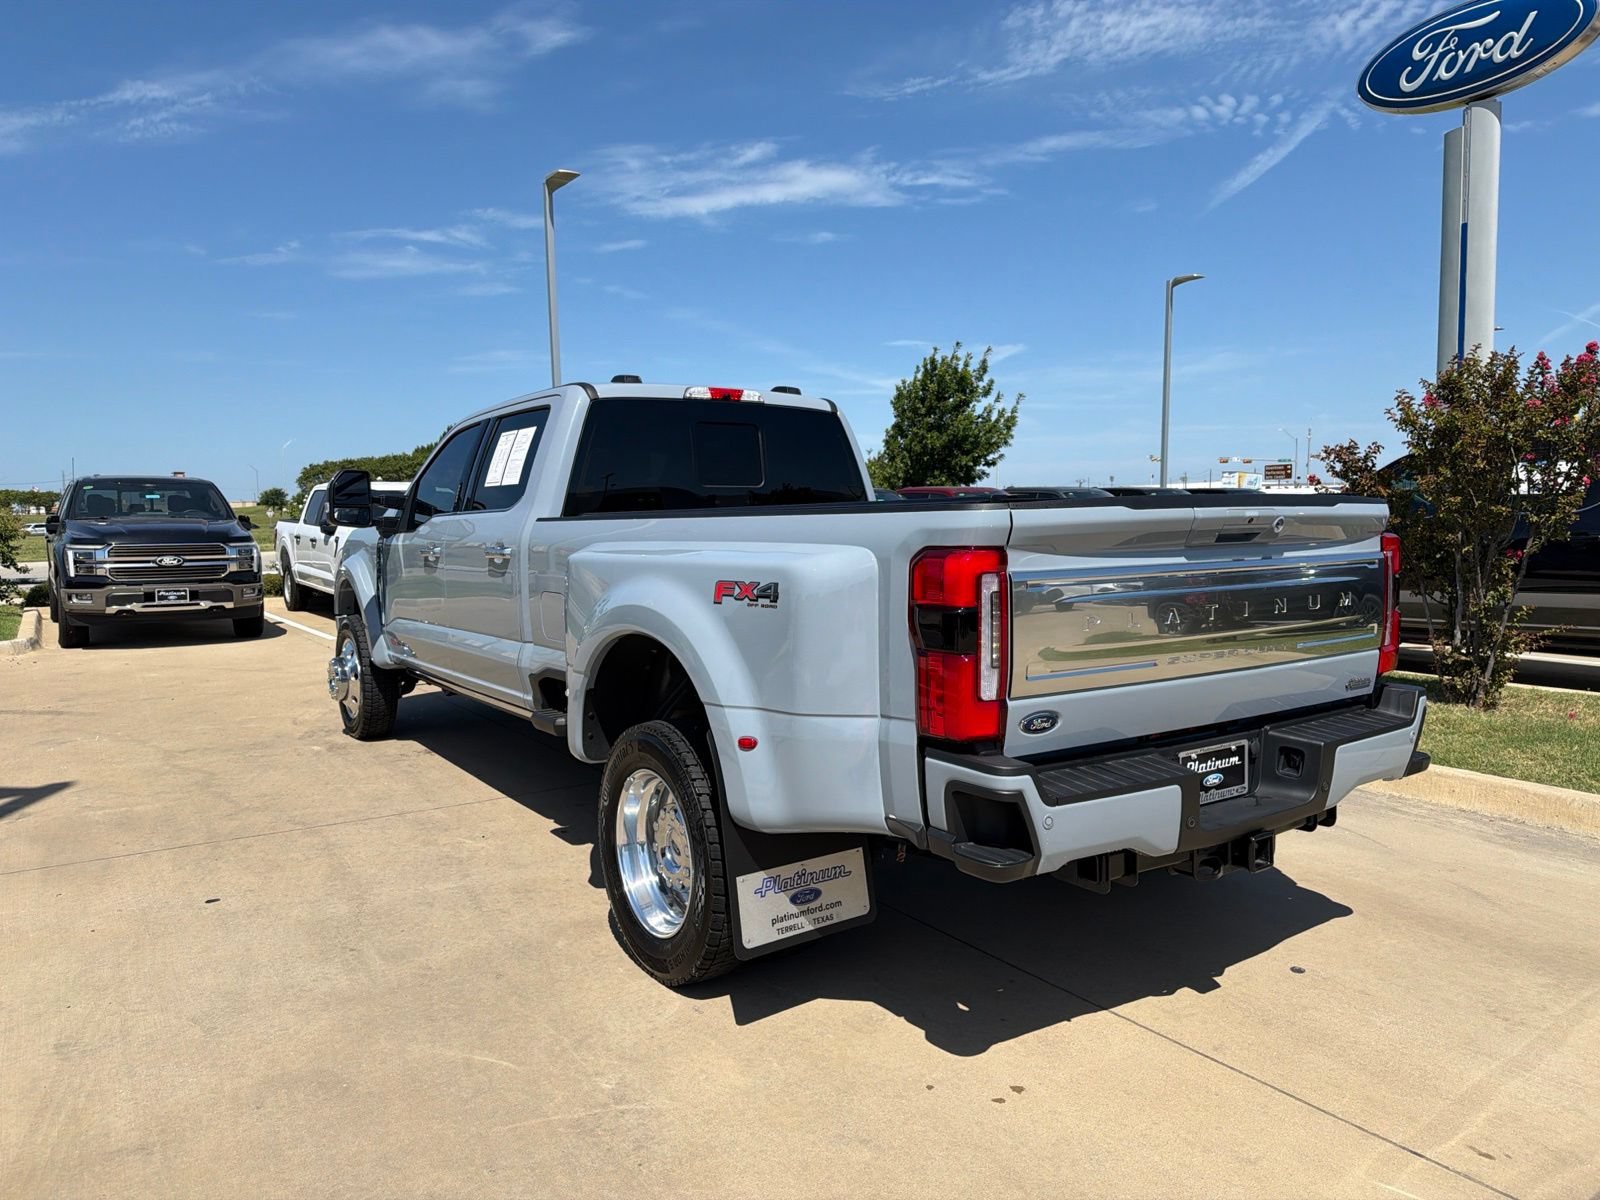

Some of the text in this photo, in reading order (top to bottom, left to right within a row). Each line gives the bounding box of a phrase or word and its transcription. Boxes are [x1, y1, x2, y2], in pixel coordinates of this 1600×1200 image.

[1399, 10, 1538, 92] Ford
[161, 557, 178, 565] Ford
[713, 580, 779, 604] FX4
[1082, 591, 1352, 632] PLATINUM
[1030, 717, 1052, 730] Ford
[753, 864, 852, 898] Platinum
[796, 889, 816, 903] Ford
[771, 900, 843, 927] platinumford.com
[776, 913, 834, 936] TERRELL TEXAS
